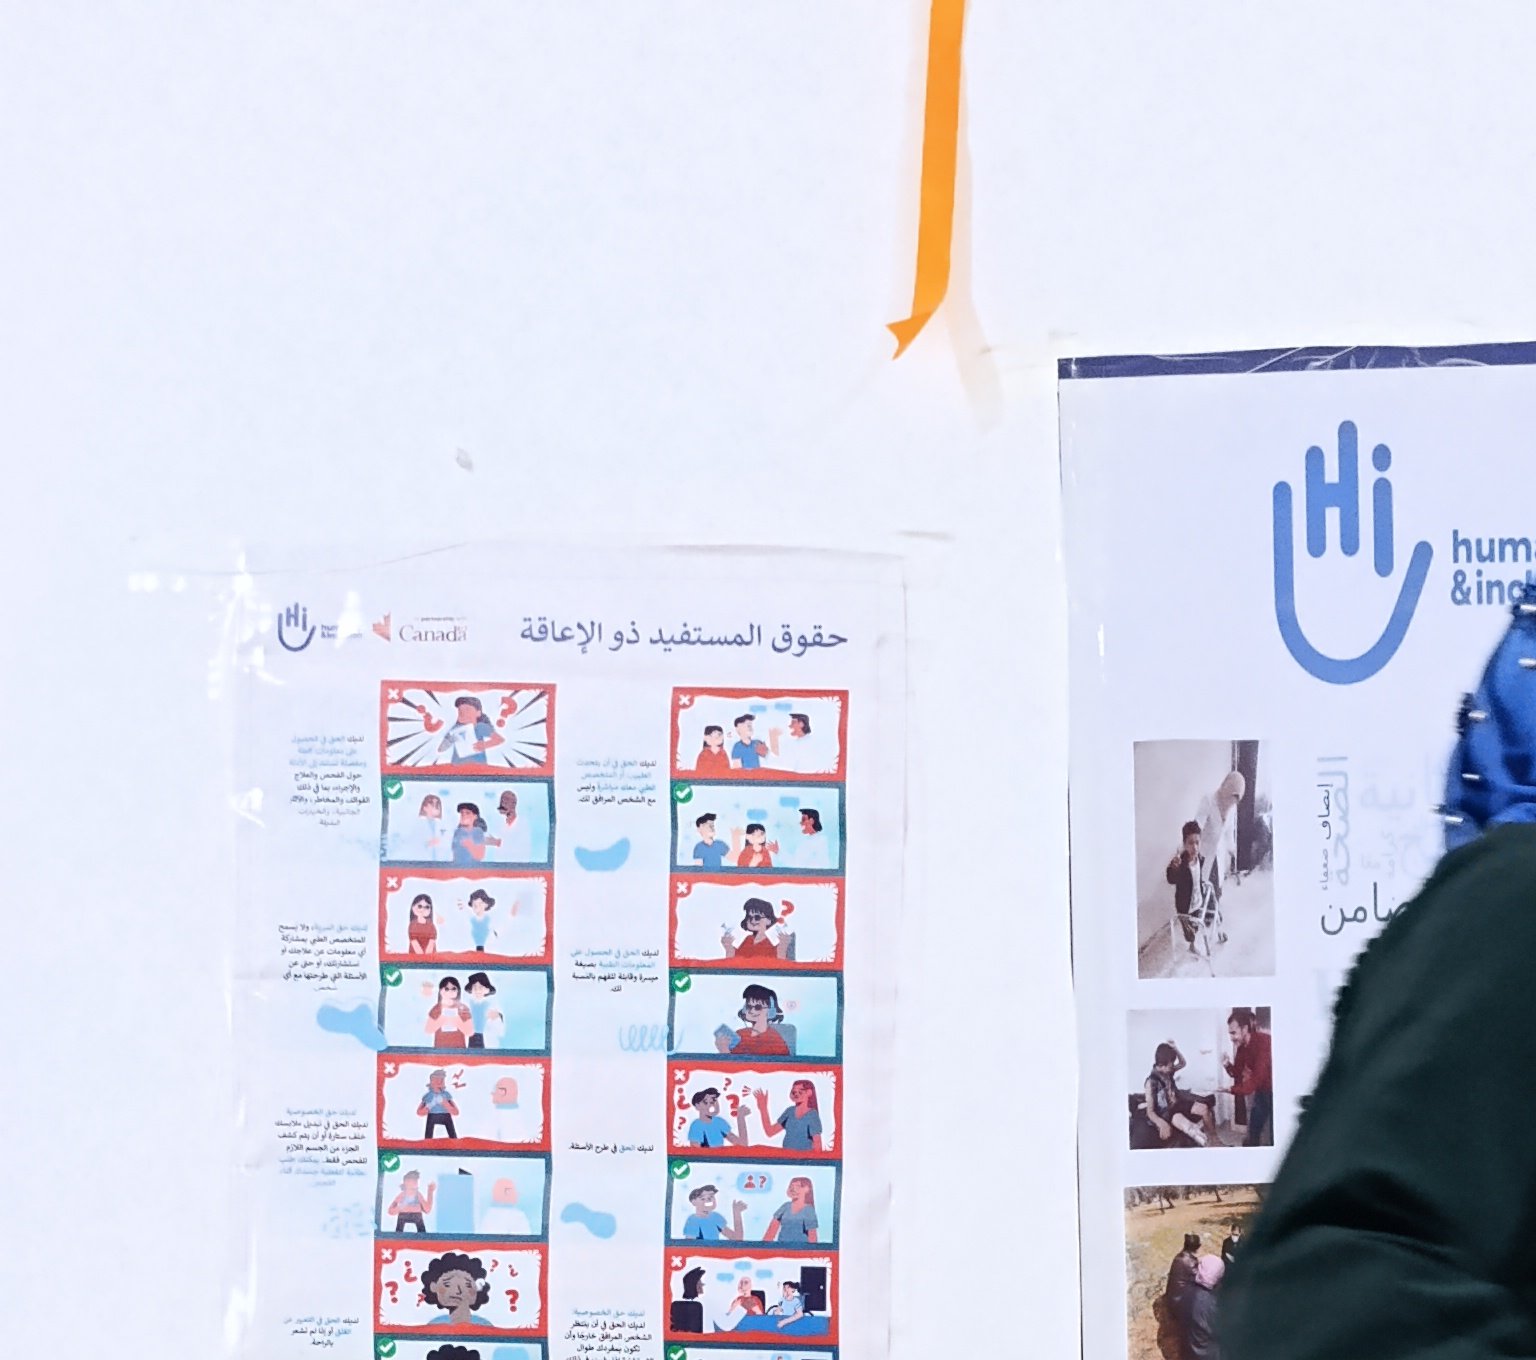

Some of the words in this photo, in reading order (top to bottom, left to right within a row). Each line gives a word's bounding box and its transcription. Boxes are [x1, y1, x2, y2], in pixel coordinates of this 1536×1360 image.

[399, 624, 467, 642] Canada
[520, 617, 602, 654] الإعاقة
[609, 621, 640, 651] ذو
[649, 622, 762, 652] المستفيد
[772, 622, 848, 657] حقوق
[313, 783, 319, 794] في
[618, 796, 645, 805] الشخص
[647, 798, 656, 806] مع
[1321, 881, 1411, 936] ضامن
[595, 1144, 609, 1153] طرح
[611, 1144, 617, 1154] في
[601, 1321, 606, 1331] في
[609, 1321, 626, 1330] الحق
[624, 1333, 652, 1342] الشخص
